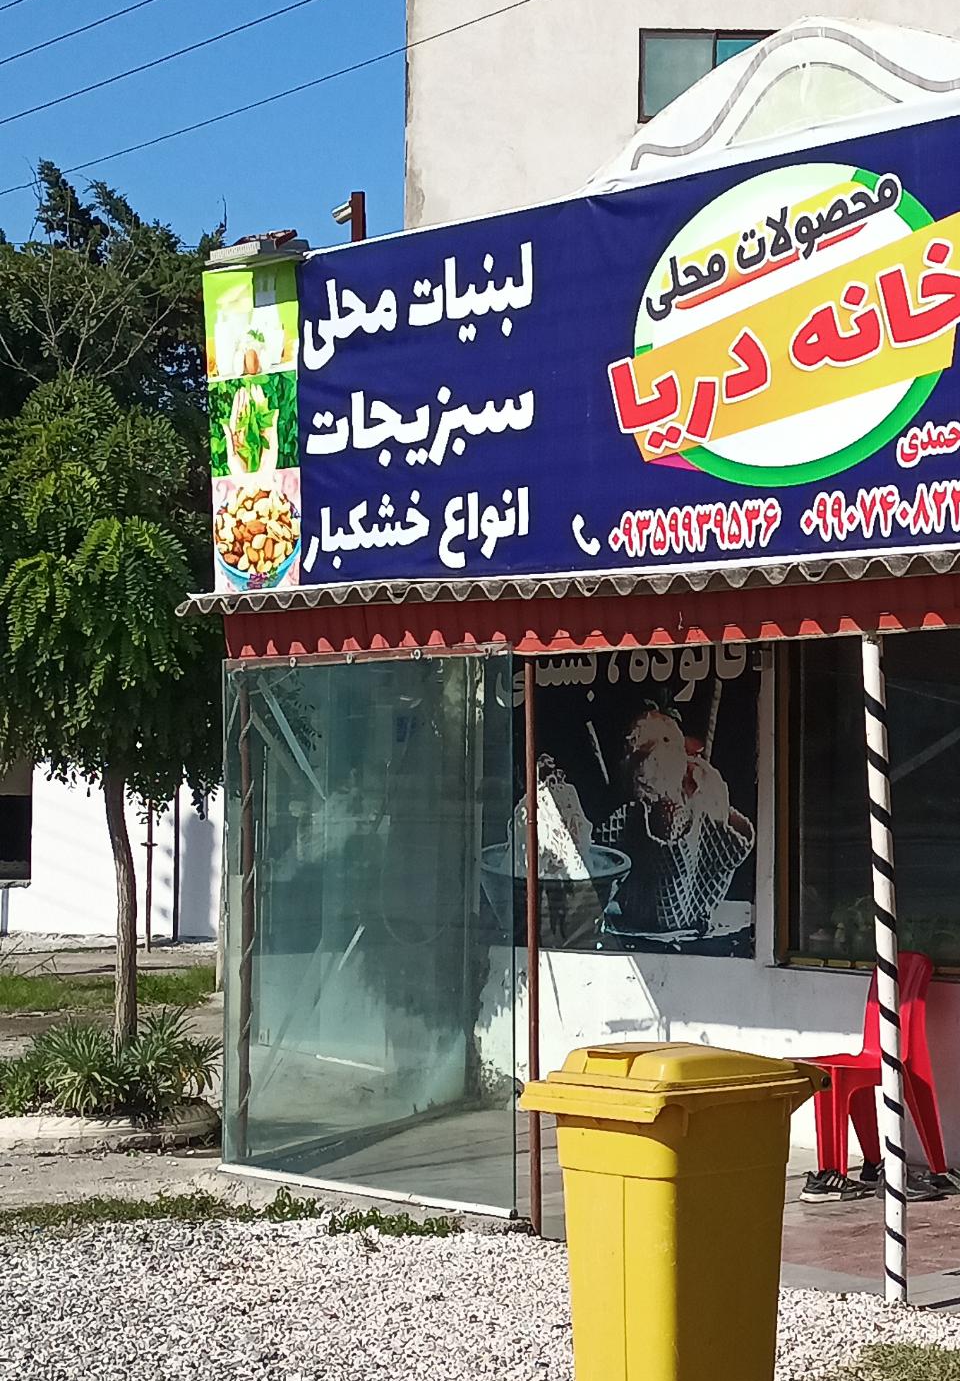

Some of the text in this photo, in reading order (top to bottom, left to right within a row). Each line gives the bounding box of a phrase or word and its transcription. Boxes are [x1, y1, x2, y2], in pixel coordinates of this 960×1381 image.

[645, 176, 899, 322] محصولات محلی
[303, 241, 533, 370] لبنیات محلی
[306, 386, 534, 467] سبزیجات
[609, 330, 769, 449] دریا
[302, 486, 529, 573] انواع خشکبار
[609, 500, 780, 555] ۰۹۳۵۹۹۳۹۵۳۶
